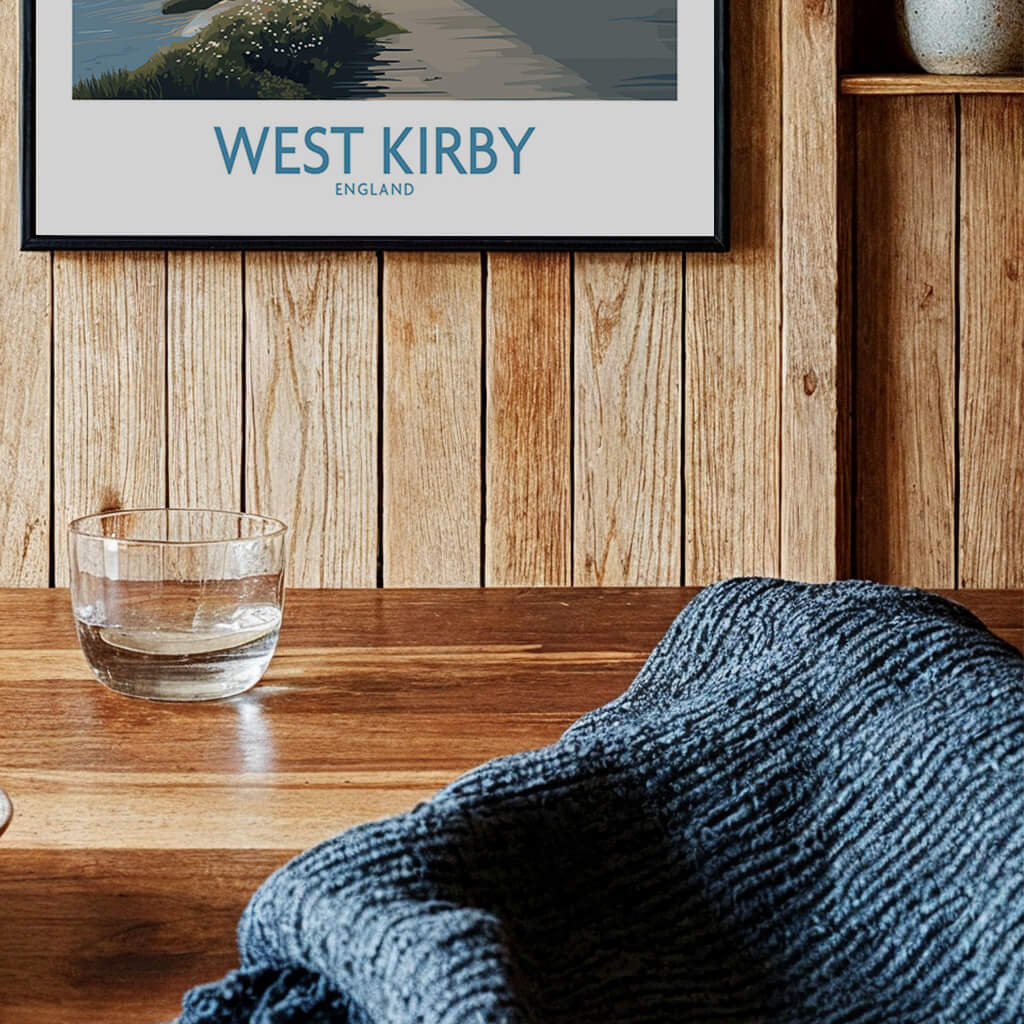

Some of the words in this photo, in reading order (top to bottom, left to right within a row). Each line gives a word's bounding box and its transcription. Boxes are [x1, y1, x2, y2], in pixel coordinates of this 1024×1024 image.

[213, 125, 365, 175] WEST
[383, 125, 536, 175] KIRBY
[335, 182, 415, 196] ENGLAND
